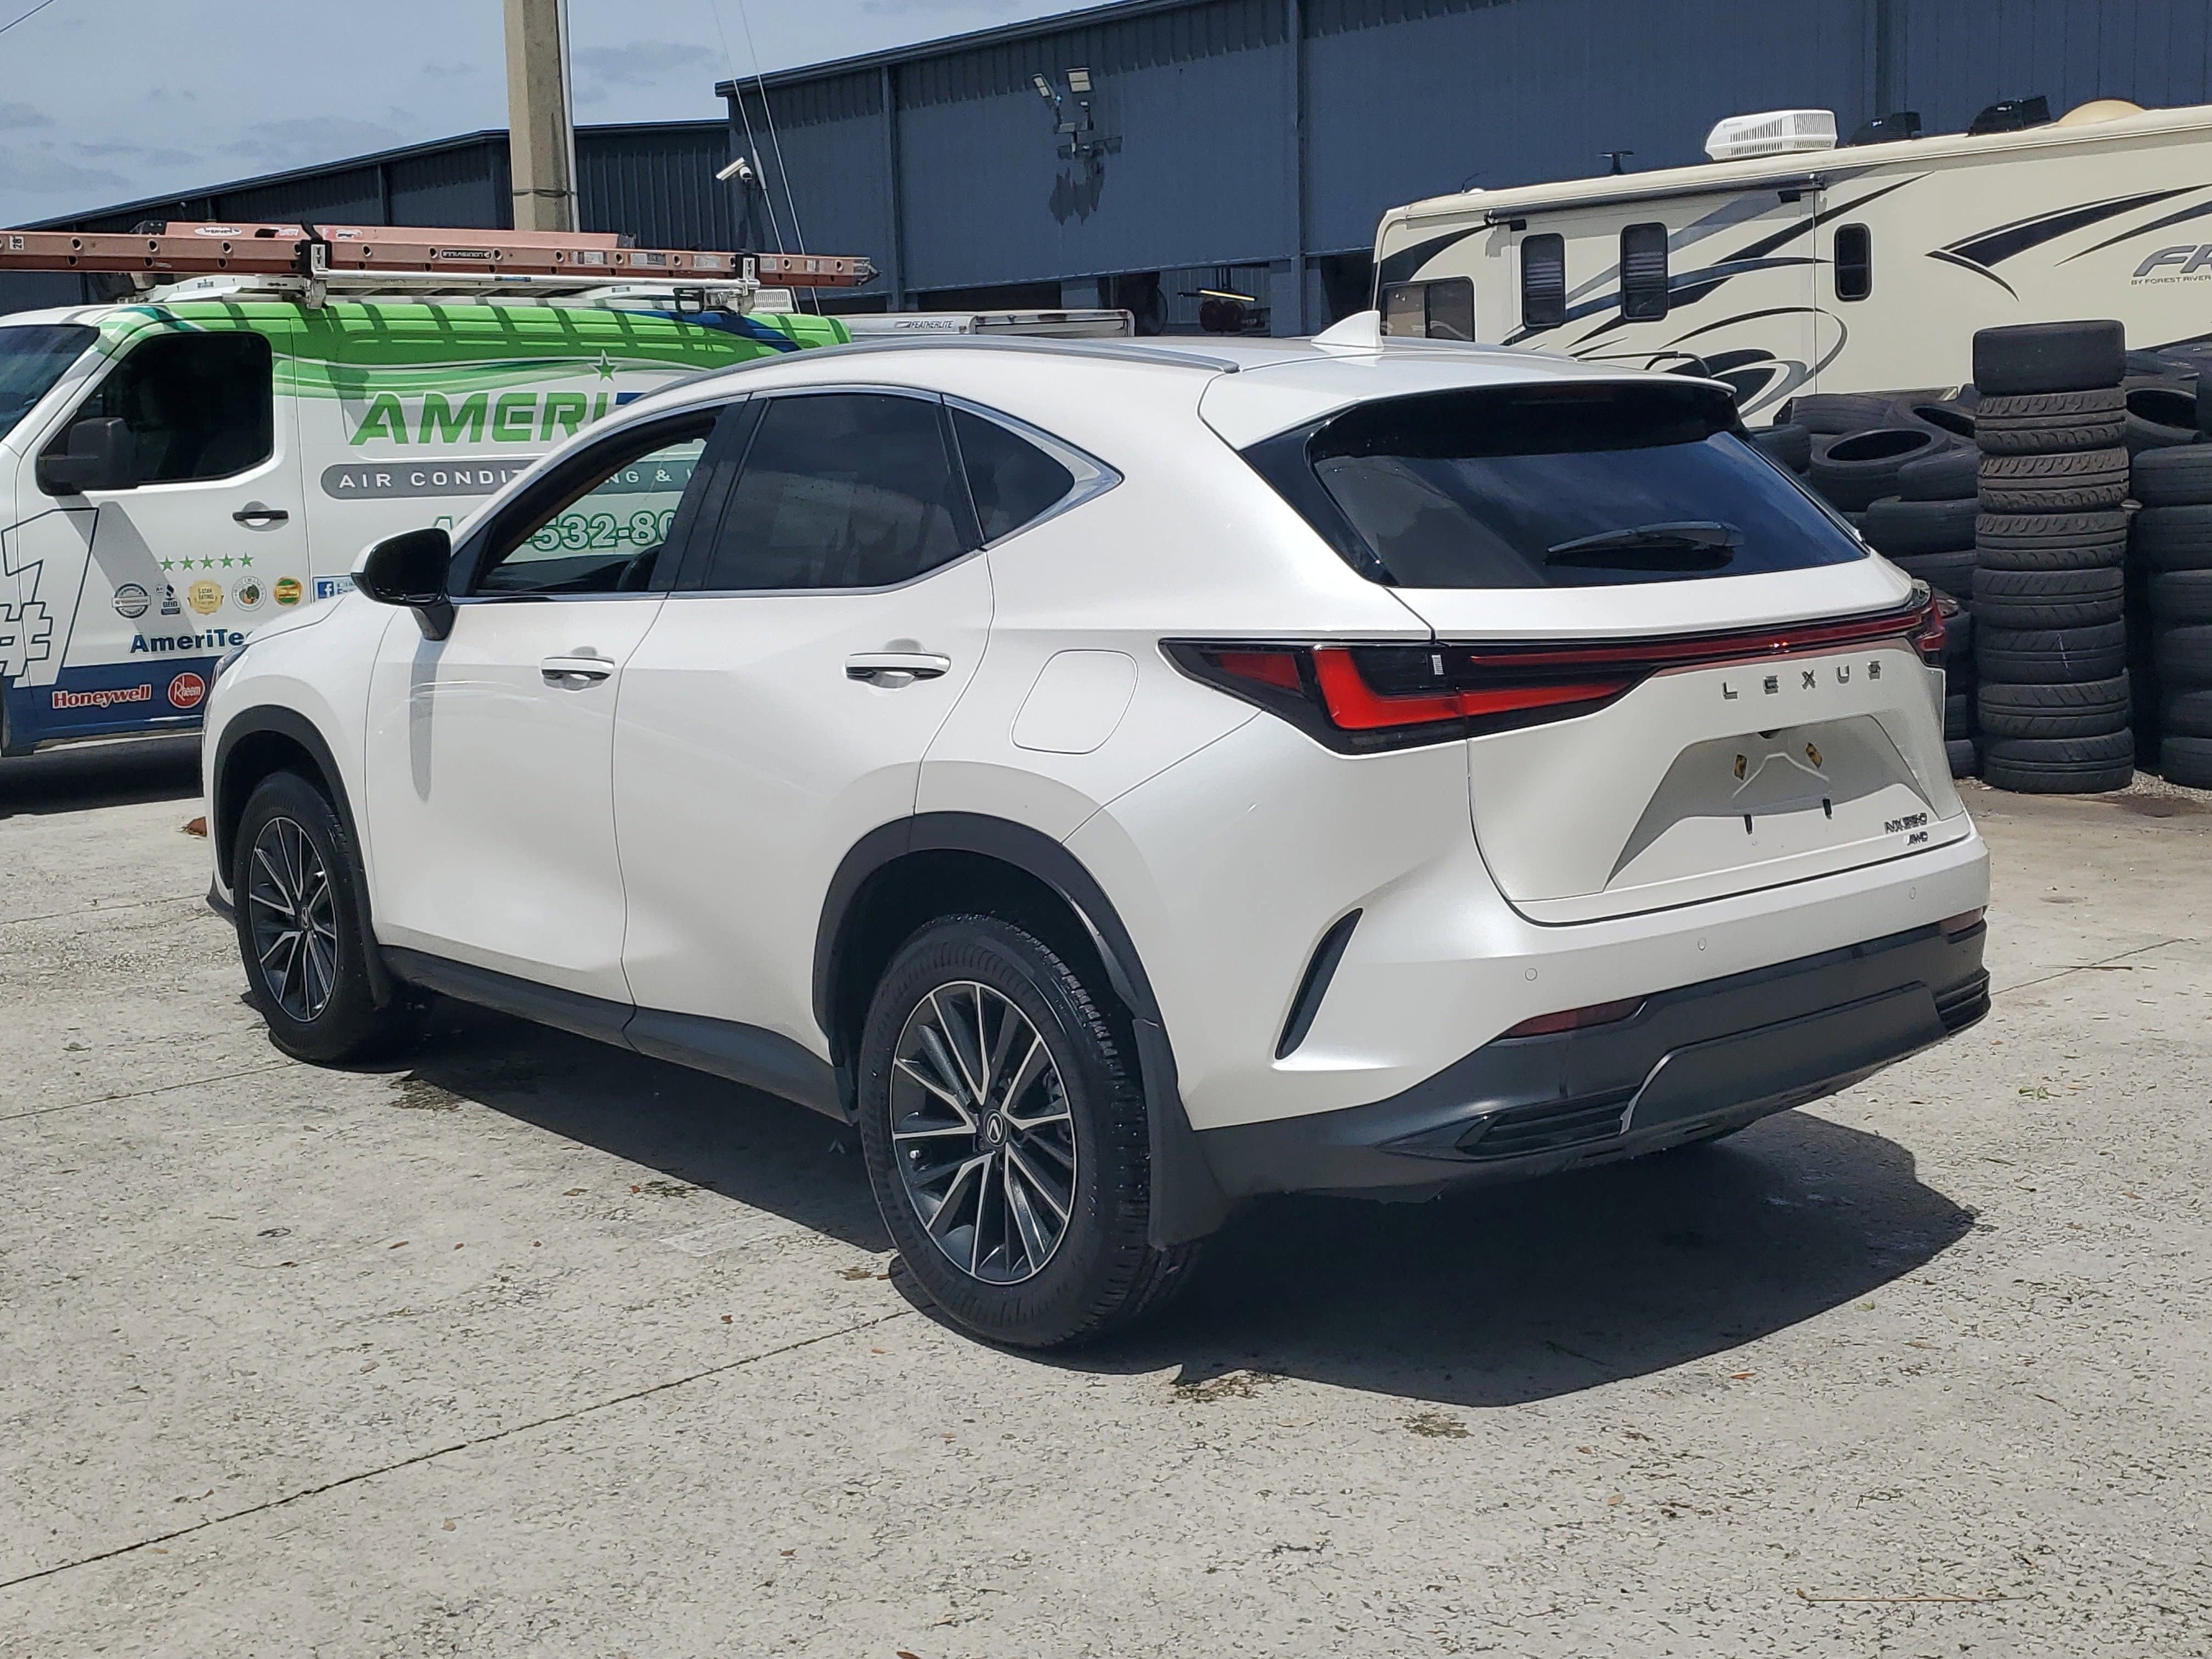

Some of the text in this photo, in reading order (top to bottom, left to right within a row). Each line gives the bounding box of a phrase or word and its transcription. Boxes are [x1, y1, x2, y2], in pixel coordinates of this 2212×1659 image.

[2145, 276, 2182, 284] FOREST
[910, 320, 953, 329] FEATHERLITE
[338, 473, 392, 488] AIR
[656, 469, 673, 482] &
[174, 676, 201, 702] Rheem
[1722, 661, 1881, 699] LEXUS
[53, 685, 151, 708] Honeywell
